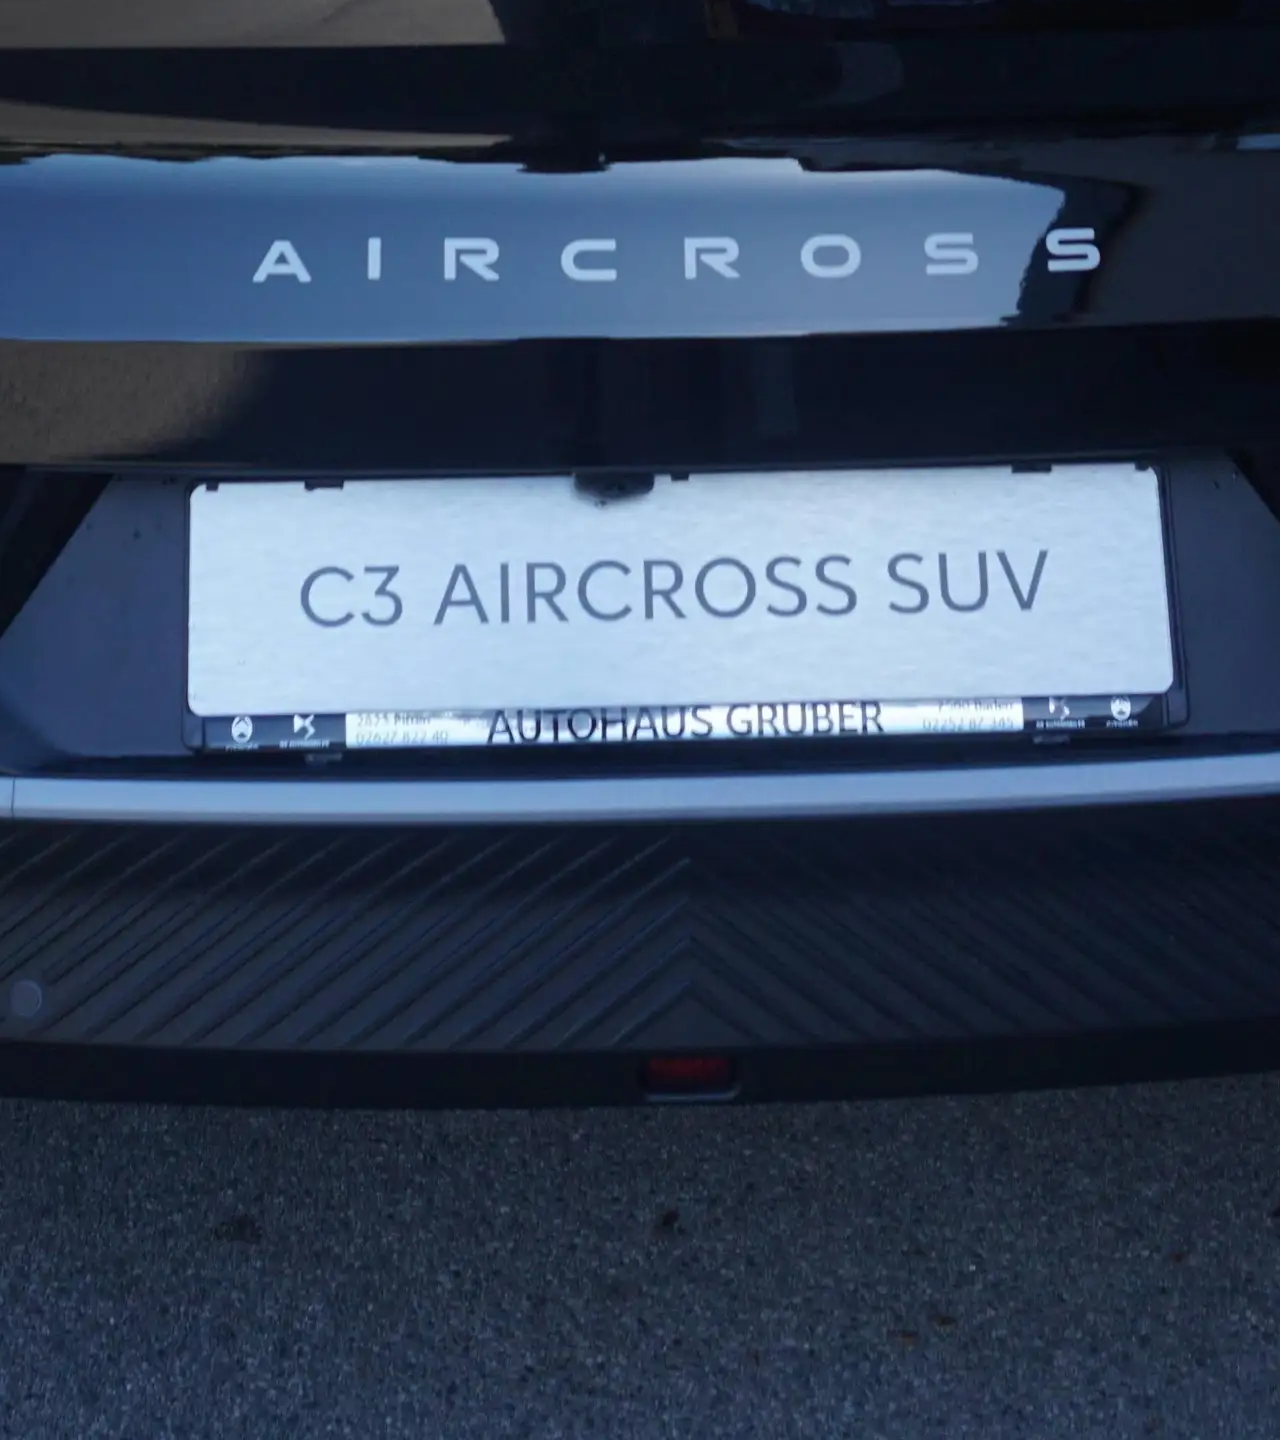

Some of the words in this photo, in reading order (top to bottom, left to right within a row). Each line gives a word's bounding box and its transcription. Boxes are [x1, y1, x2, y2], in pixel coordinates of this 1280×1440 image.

[252, 228, 1101, 283] AIRCROSS
[300, 565, 404, 628] C3
[434, 554, 857, 626] AIRCROSS
[887, 549, 1049, 614] SUV
[487, 706, 713, 744] AUTOHAUS
[726, 700, 885, 736] GRUBER
